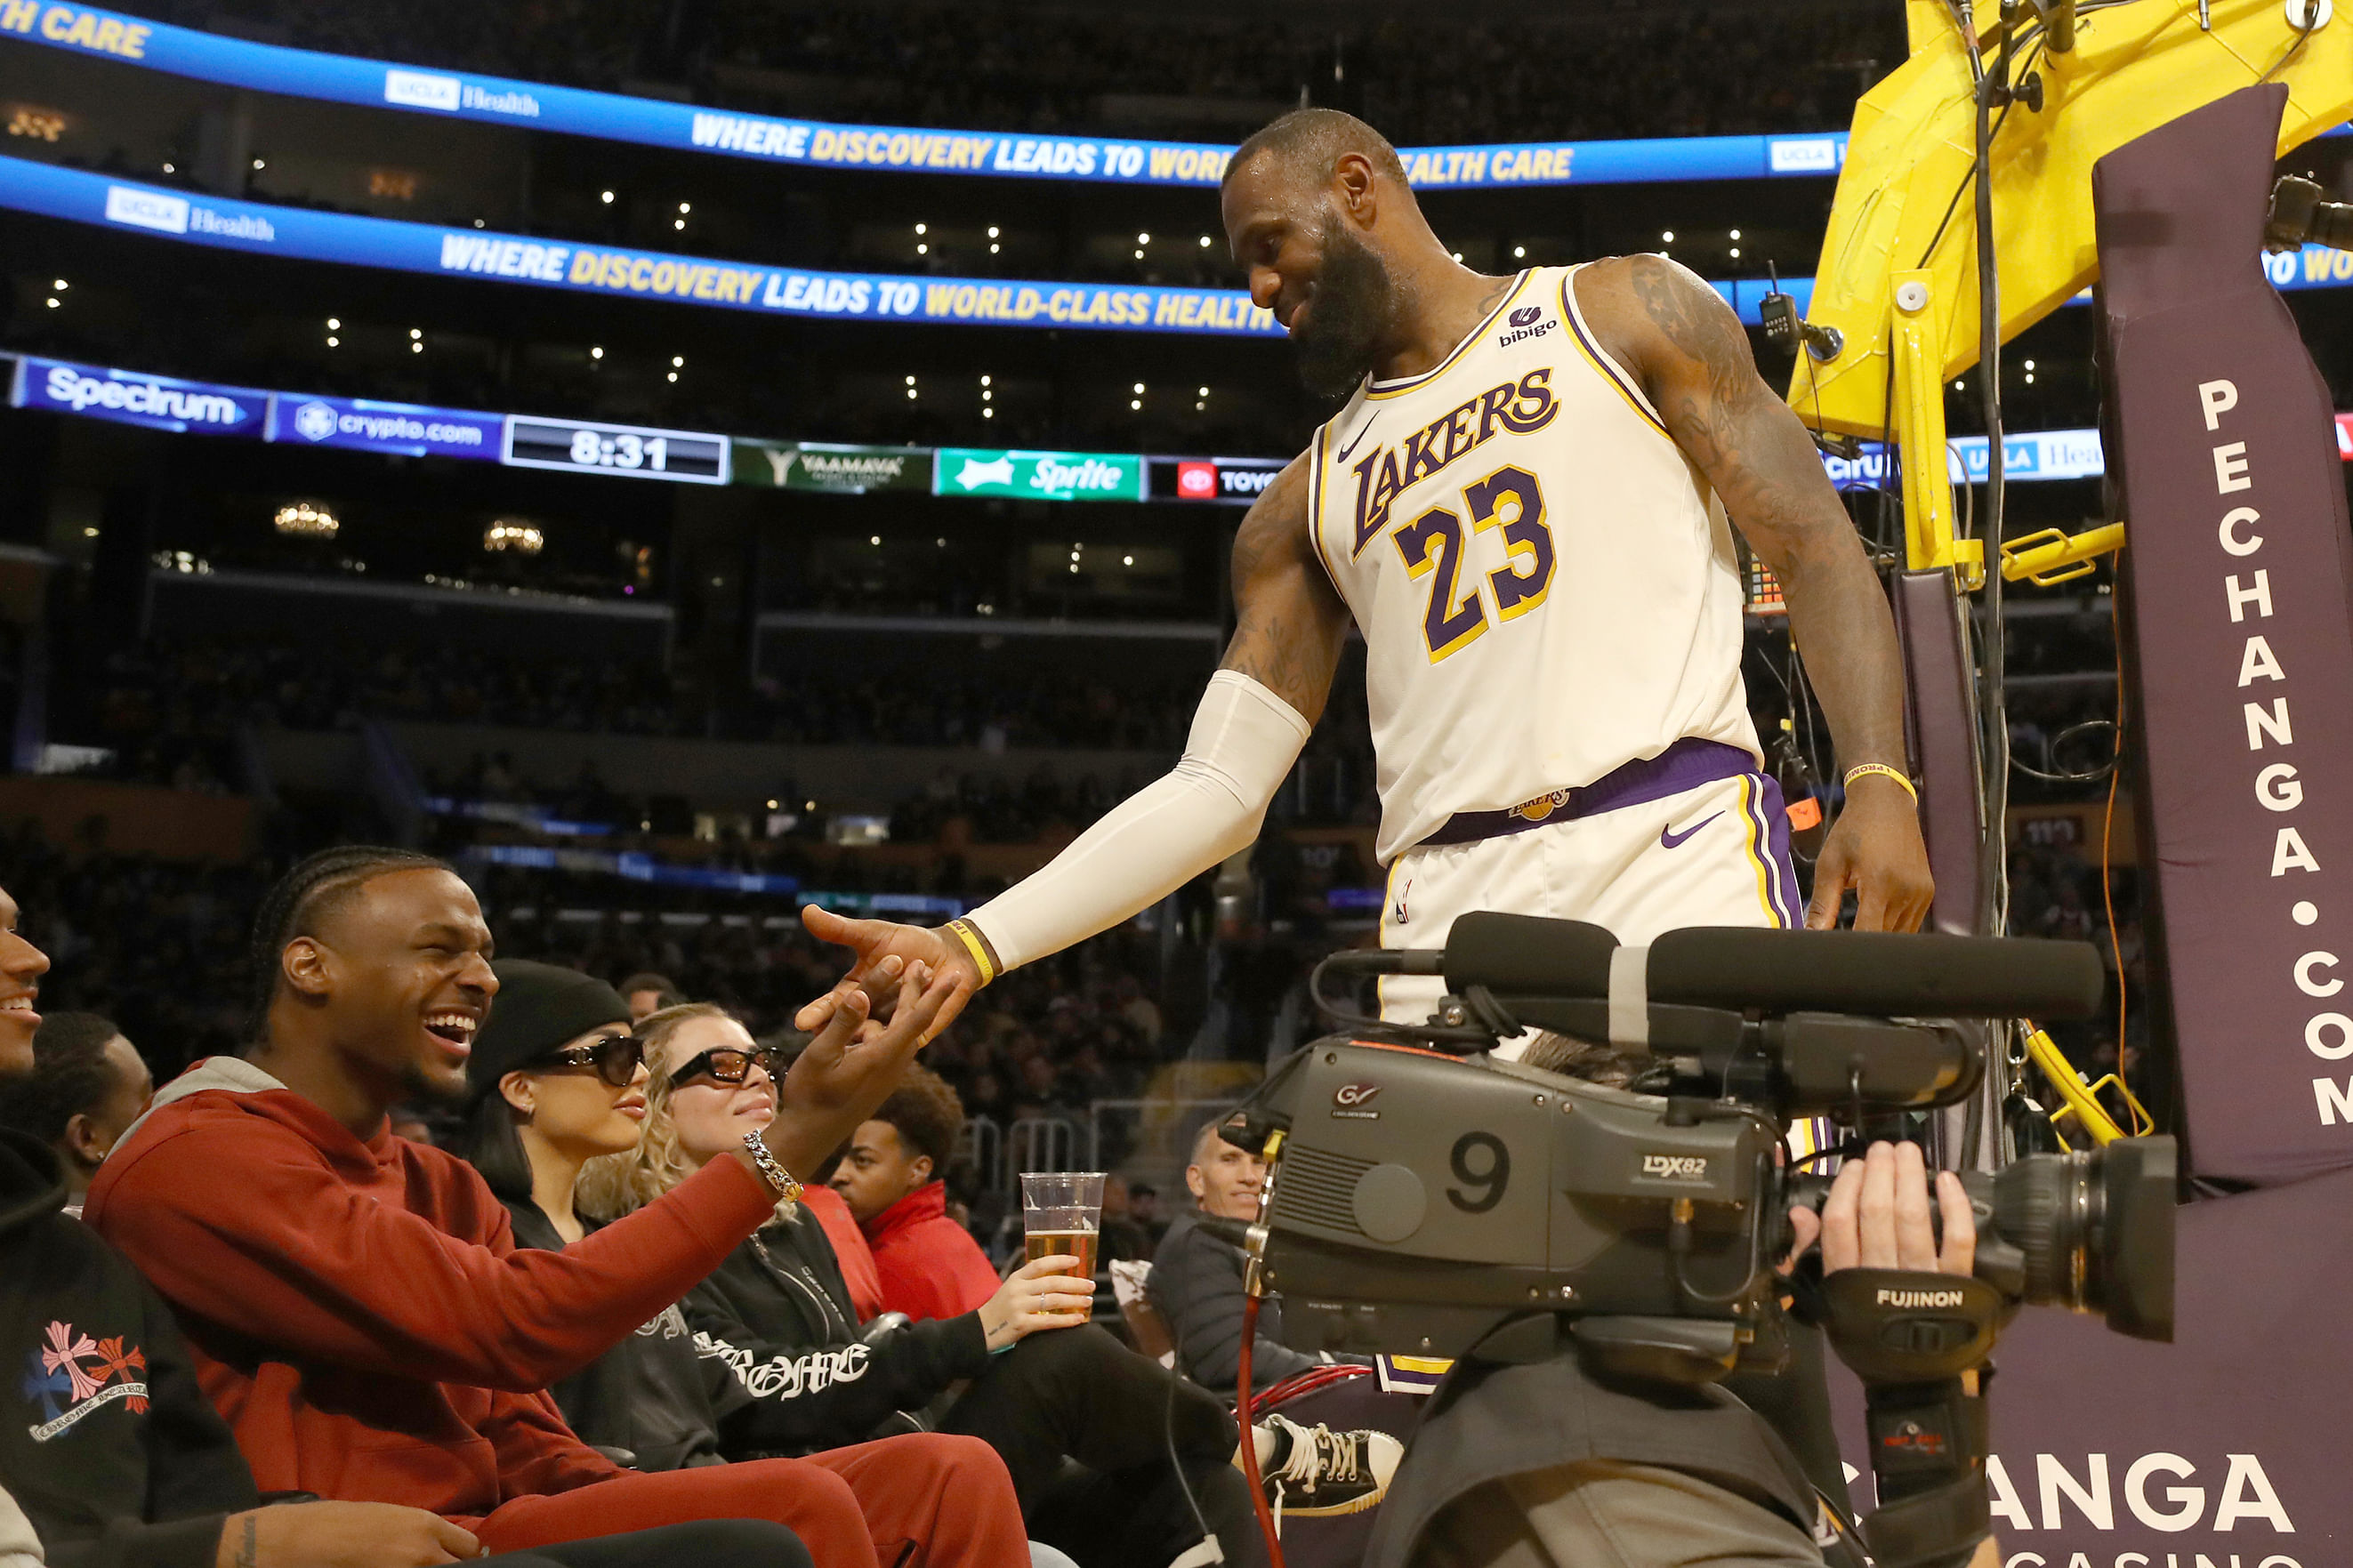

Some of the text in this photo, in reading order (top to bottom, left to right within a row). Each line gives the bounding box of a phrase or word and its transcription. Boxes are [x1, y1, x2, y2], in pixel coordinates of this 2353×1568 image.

[41, 6, 152, 59] CARE
[691, 113, 810, 158] WHERE
[810, 129, 993, 168] DISCOVERY
[994, 140, 1098, 175] LEADS
[1103, 145, 1144, 177] TO
[1490, 149, 1575, 181] CARE
[190, 207, 275, 241] Health
[440, 234, 1276, 330] WHERE DISCOVERY LEADS TO WORLD-CLASS HEALTH
[1499, 318, 1558, 348] bibigo
[45, 366, 237, 425] Spectrum
[339, 413, 482, 446] crypto.com
[569, 430, 669, 472] 8:31
[1029, 458, 1123, 494] Sprite
[1350, 366, 1562, 567] LAKERS
[1968, 443, 2101, 471] ULA Hea
[1390, 463, 1558, 666] 23
[1446, 1130, 1511, 1214] 9
[1642, 1155, 1707, 1178] LDX82
[1877, 1289, 1963, 1308] FUJINON
[692, 1331, 871, 1401] ROME
[1841, 1451, 2296, 1532] ANGA
